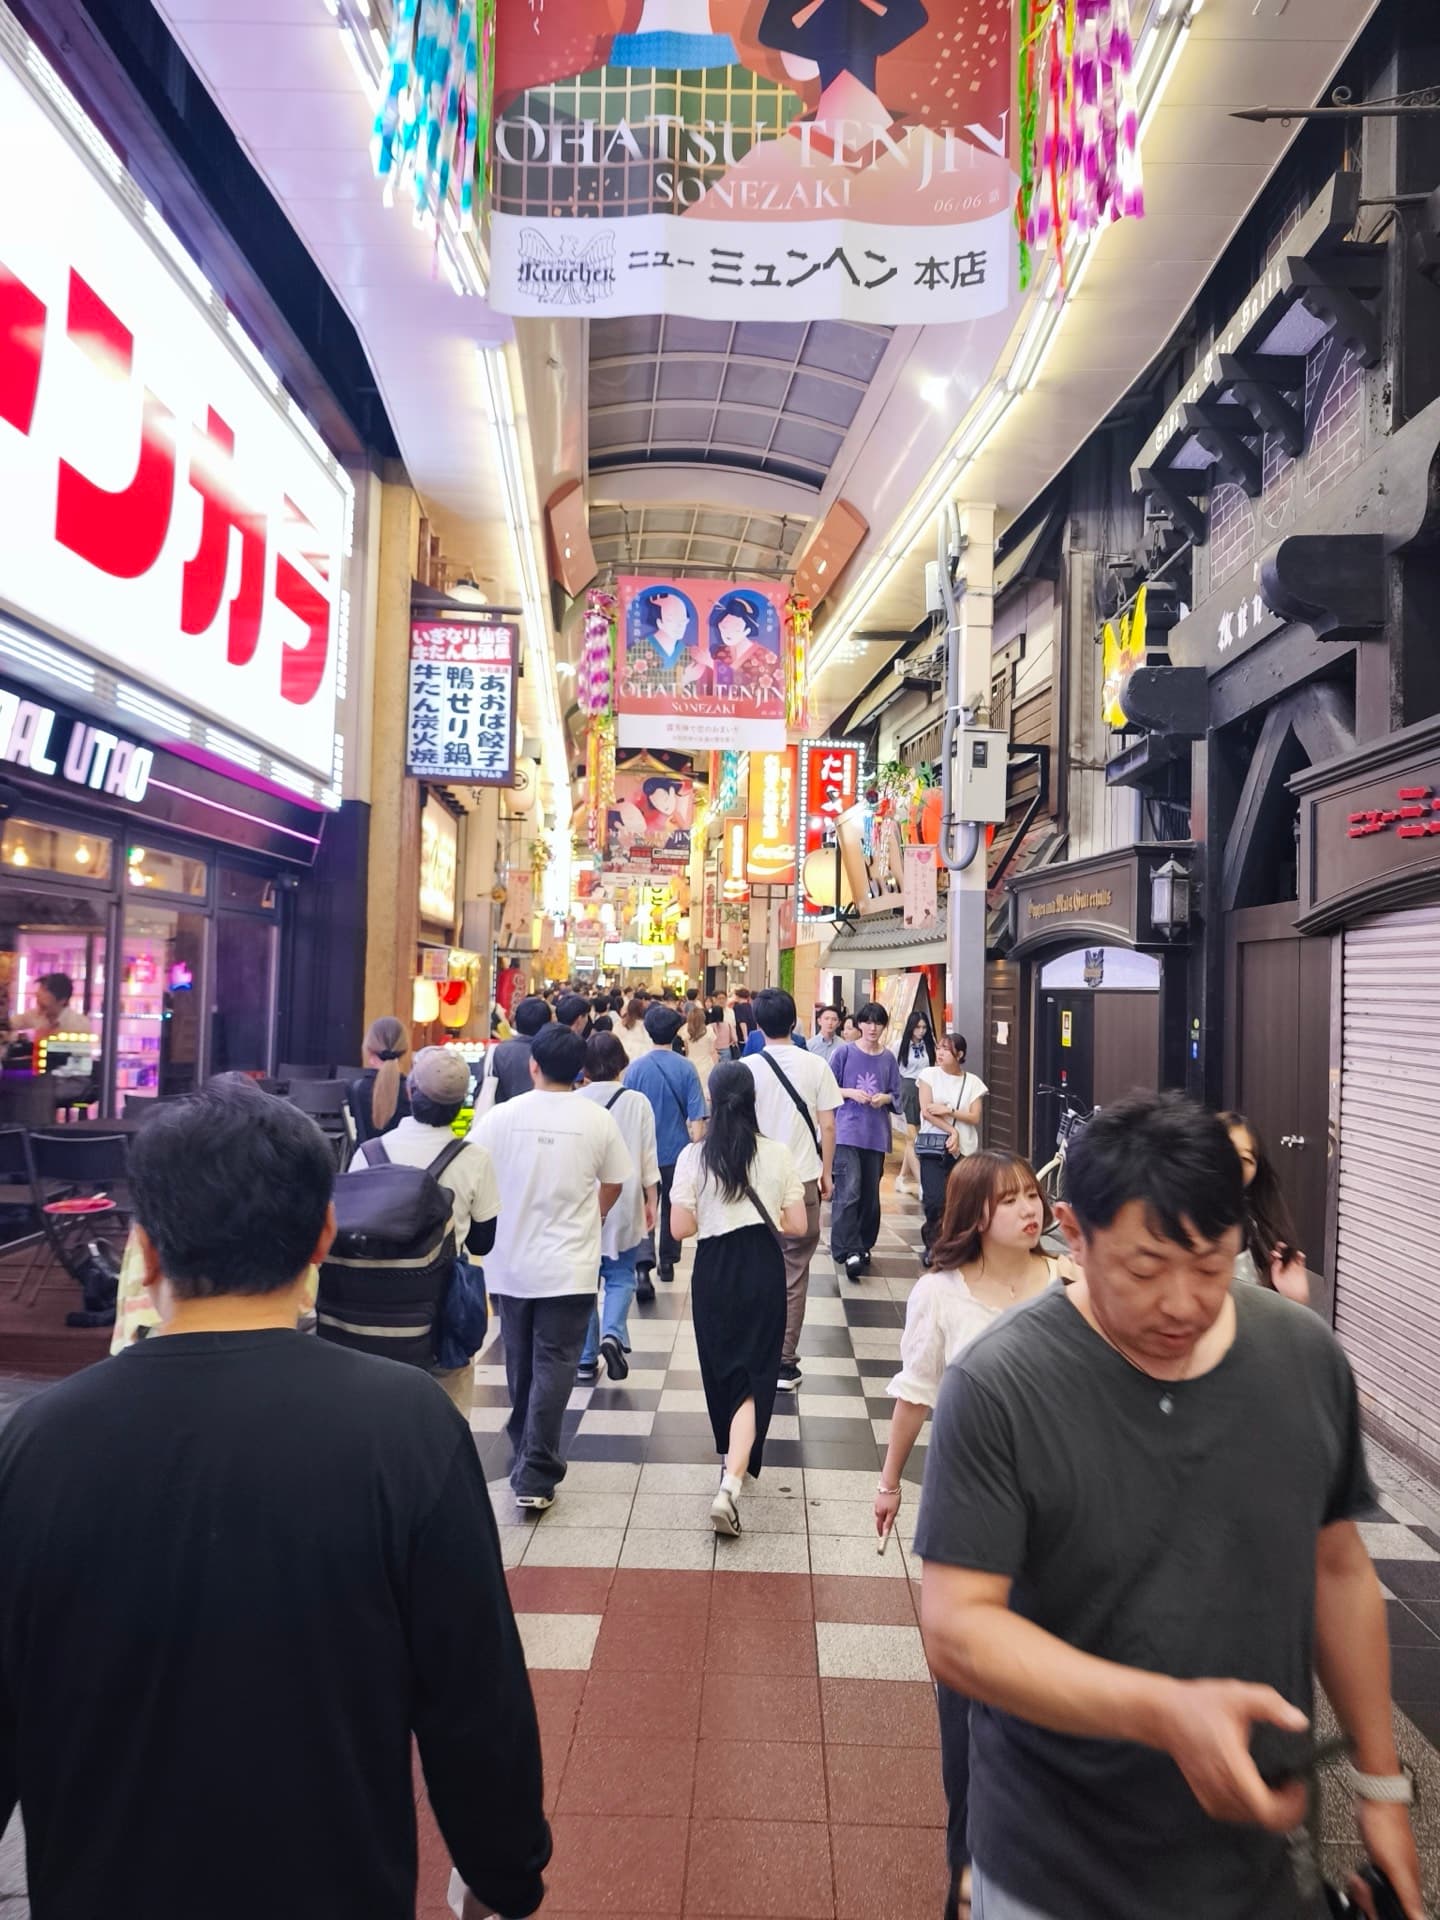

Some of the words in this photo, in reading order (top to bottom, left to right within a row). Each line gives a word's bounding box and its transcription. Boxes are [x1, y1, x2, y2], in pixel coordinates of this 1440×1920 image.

[495, 114, 768, 169] OHATSU
[786, 109, 1010, 192] TENJIN
[656, 172, 853, 210] SONEZAKI
[709, 247, 898, 289] ミュンヘン
[913, 250, 988, 290] 本店
[0, 260, 331, 705] ンカラ
[410, 664, 442, 764] 牛たん炭火焼
[444, 666, 475, 766] 鴨せり鍋
[478, 674, 506, 768] あおば餃子
[672, 701, 736, 715] SONEZAKI
[713, 683, 785, 707] TENJIN
[63, 720, 155, 803] UTAO
